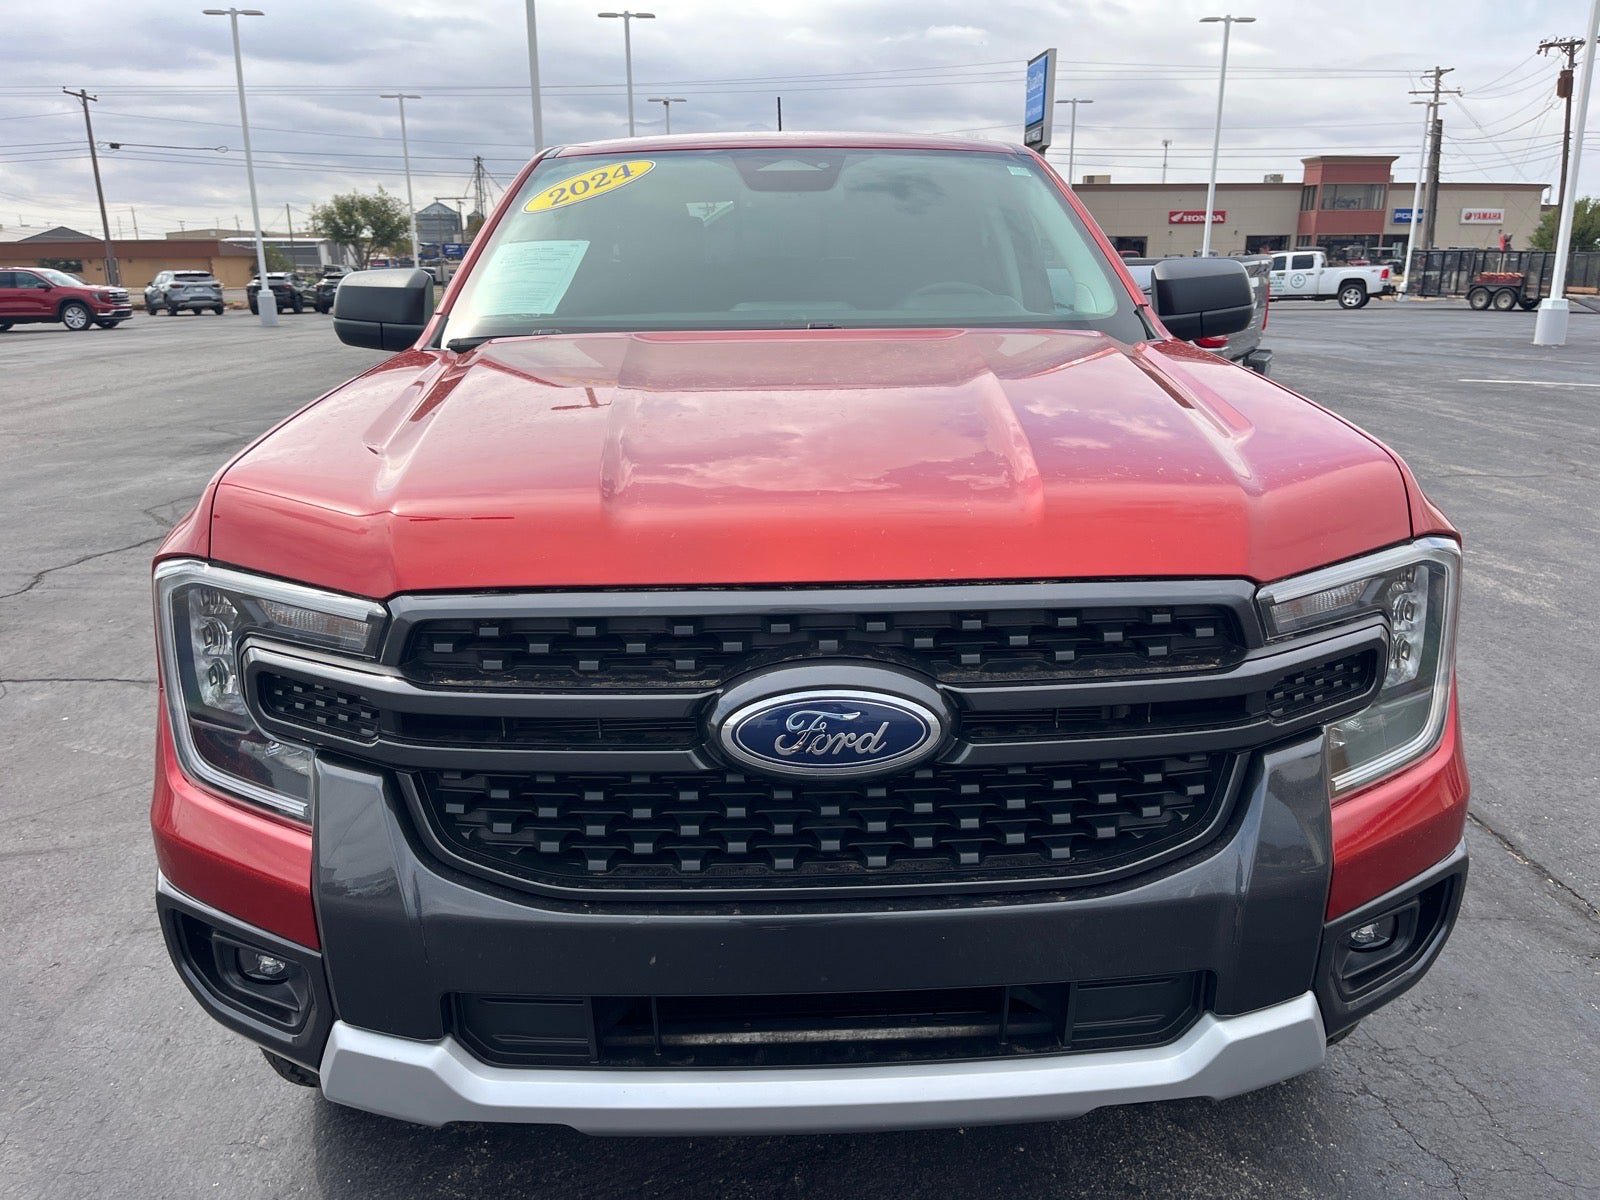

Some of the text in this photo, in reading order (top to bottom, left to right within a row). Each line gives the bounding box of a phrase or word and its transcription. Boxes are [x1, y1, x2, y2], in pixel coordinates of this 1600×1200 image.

[548, 164, 635, 206] 2024
[1472, 211, 1502, 221] YAMAHA
[774, 709, 890, 756] Ford
